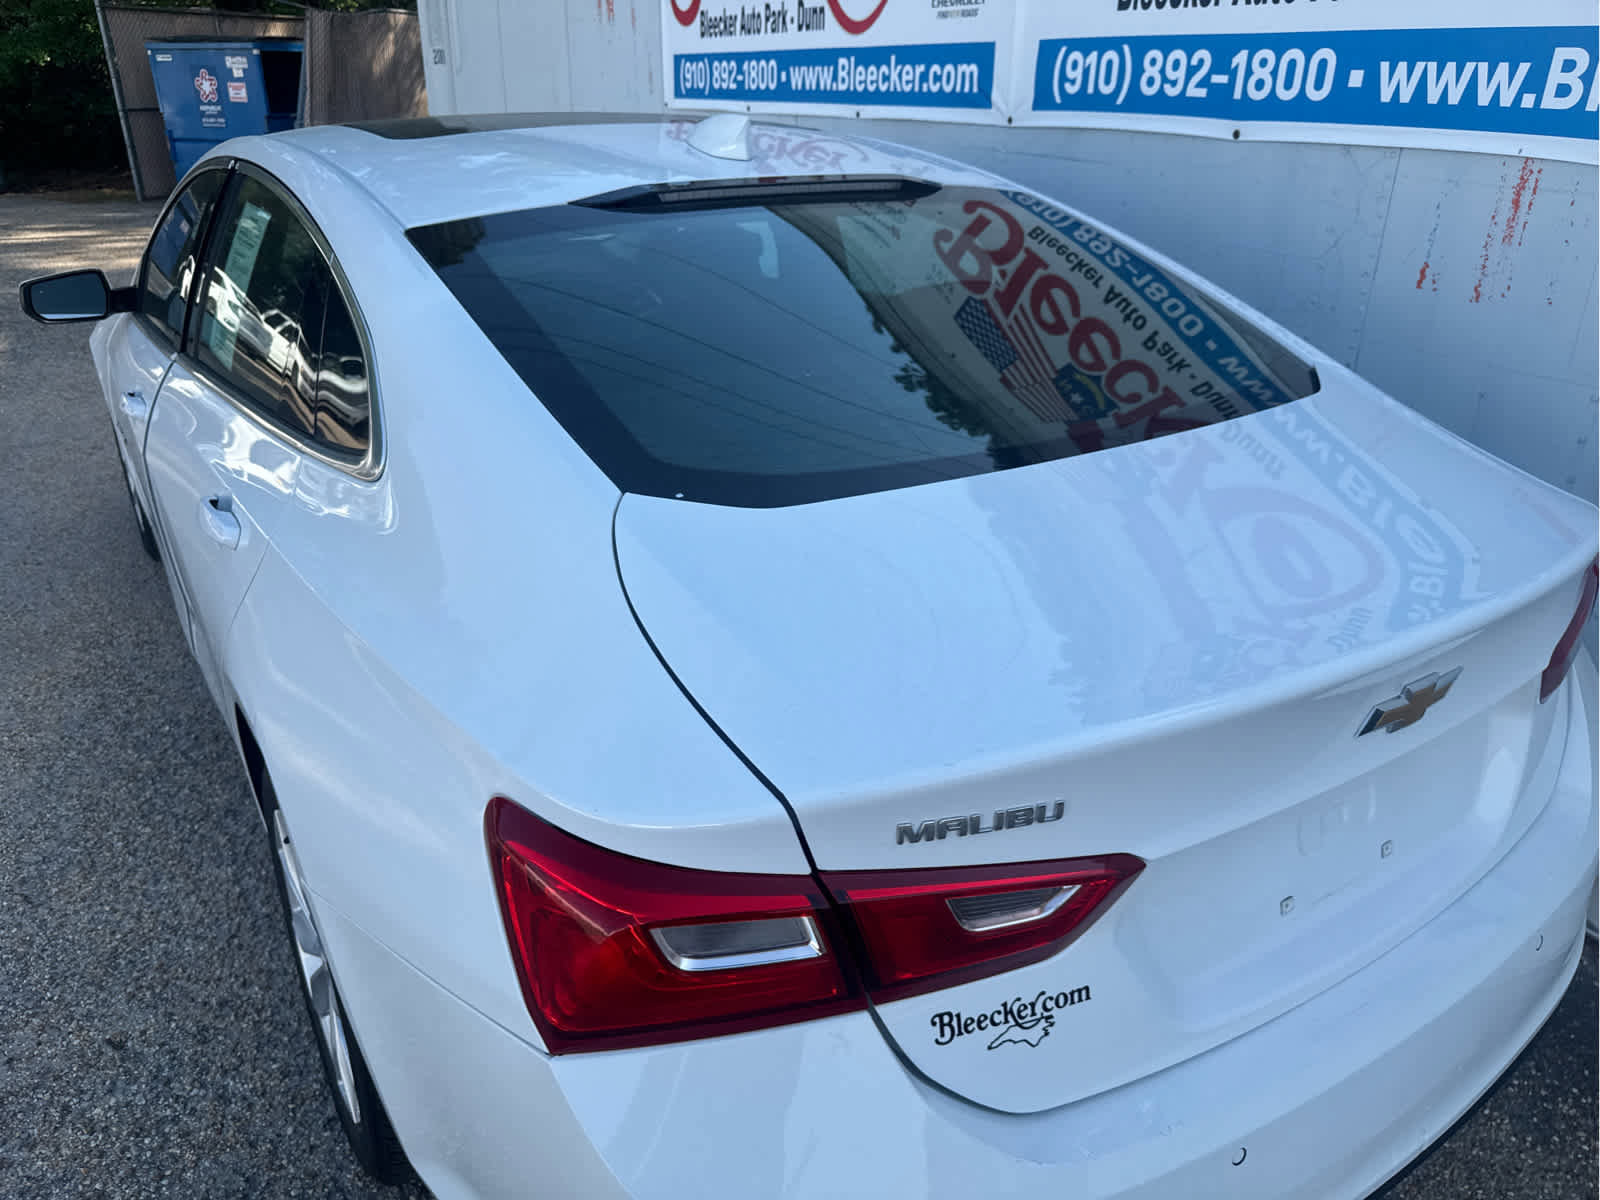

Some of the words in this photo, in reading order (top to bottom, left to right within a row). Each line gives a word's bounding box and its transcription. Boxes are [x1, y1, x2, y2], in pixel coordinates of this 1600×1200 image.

[700, 9, 738, 38] Bleecker
[740, 8, 762, 35] Auto
[764, 4, 788, 34] Park
[797, 2, 825, 32] Dunn
[680, 58, 710, 95] (910)
[712, 59, 777, 91] 892-1800
[790, 56, 979, 94] www.Bleecker.com
[1053, 45, 1132, 104] (910)
[1140, 48, 1337, 102] 892-1800
[895, 799, 1065, 845] MALIBU
